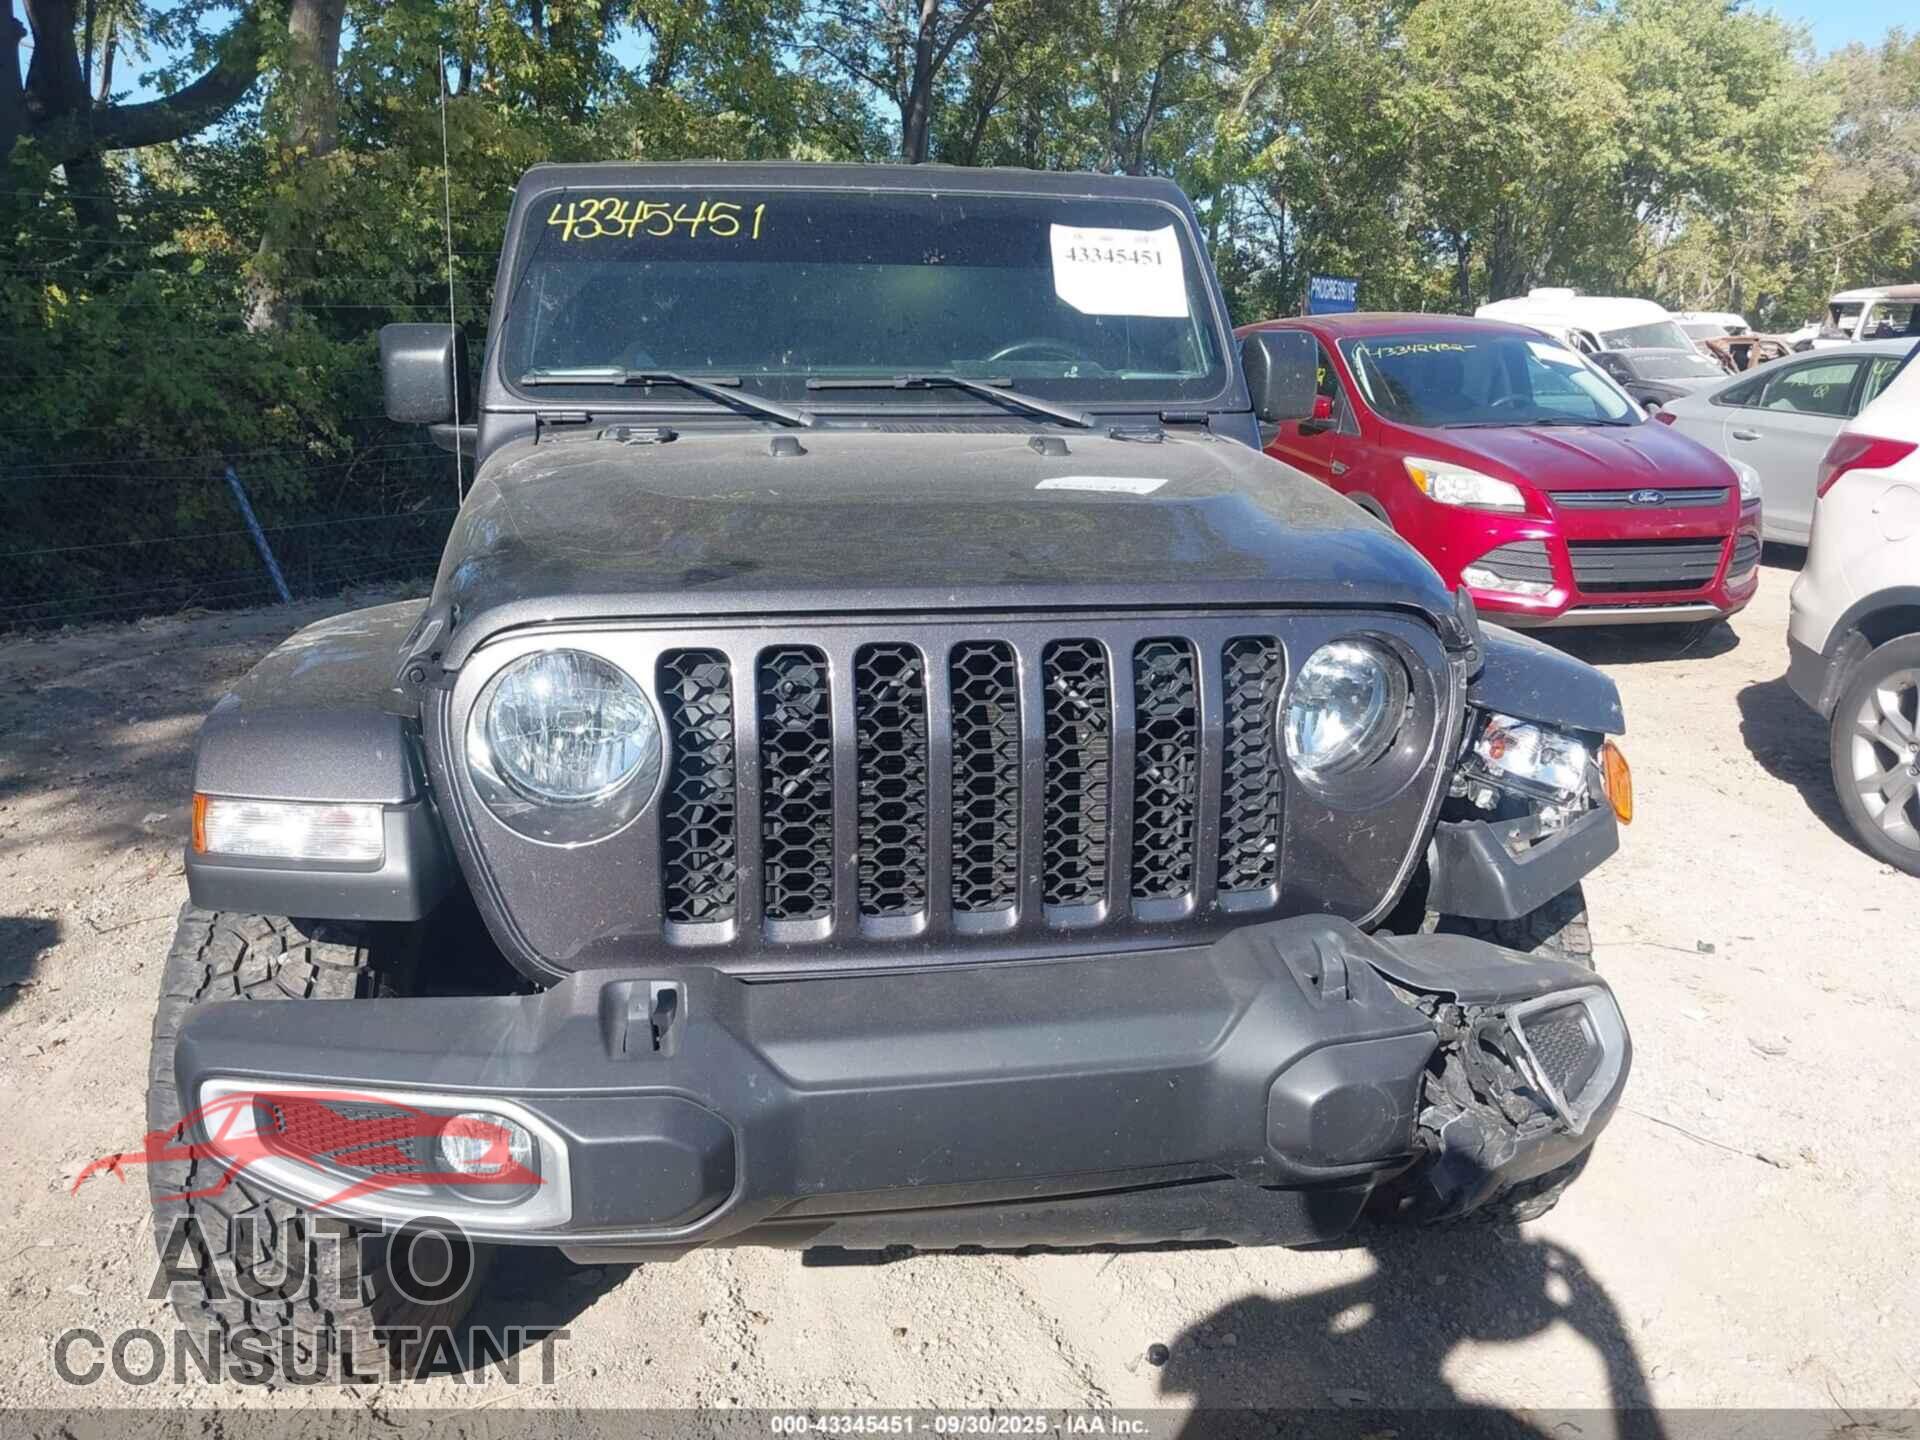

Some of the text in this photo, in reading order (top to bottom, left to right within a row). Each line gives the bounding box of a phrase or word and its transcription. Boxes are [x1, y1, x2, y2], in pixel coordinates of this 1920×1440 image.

[547, 197, 765, 242] 43345451
[1066, 246, 1162, 265] 43345451
[1311, 277, 1357, 301] PROGRESSIVE
